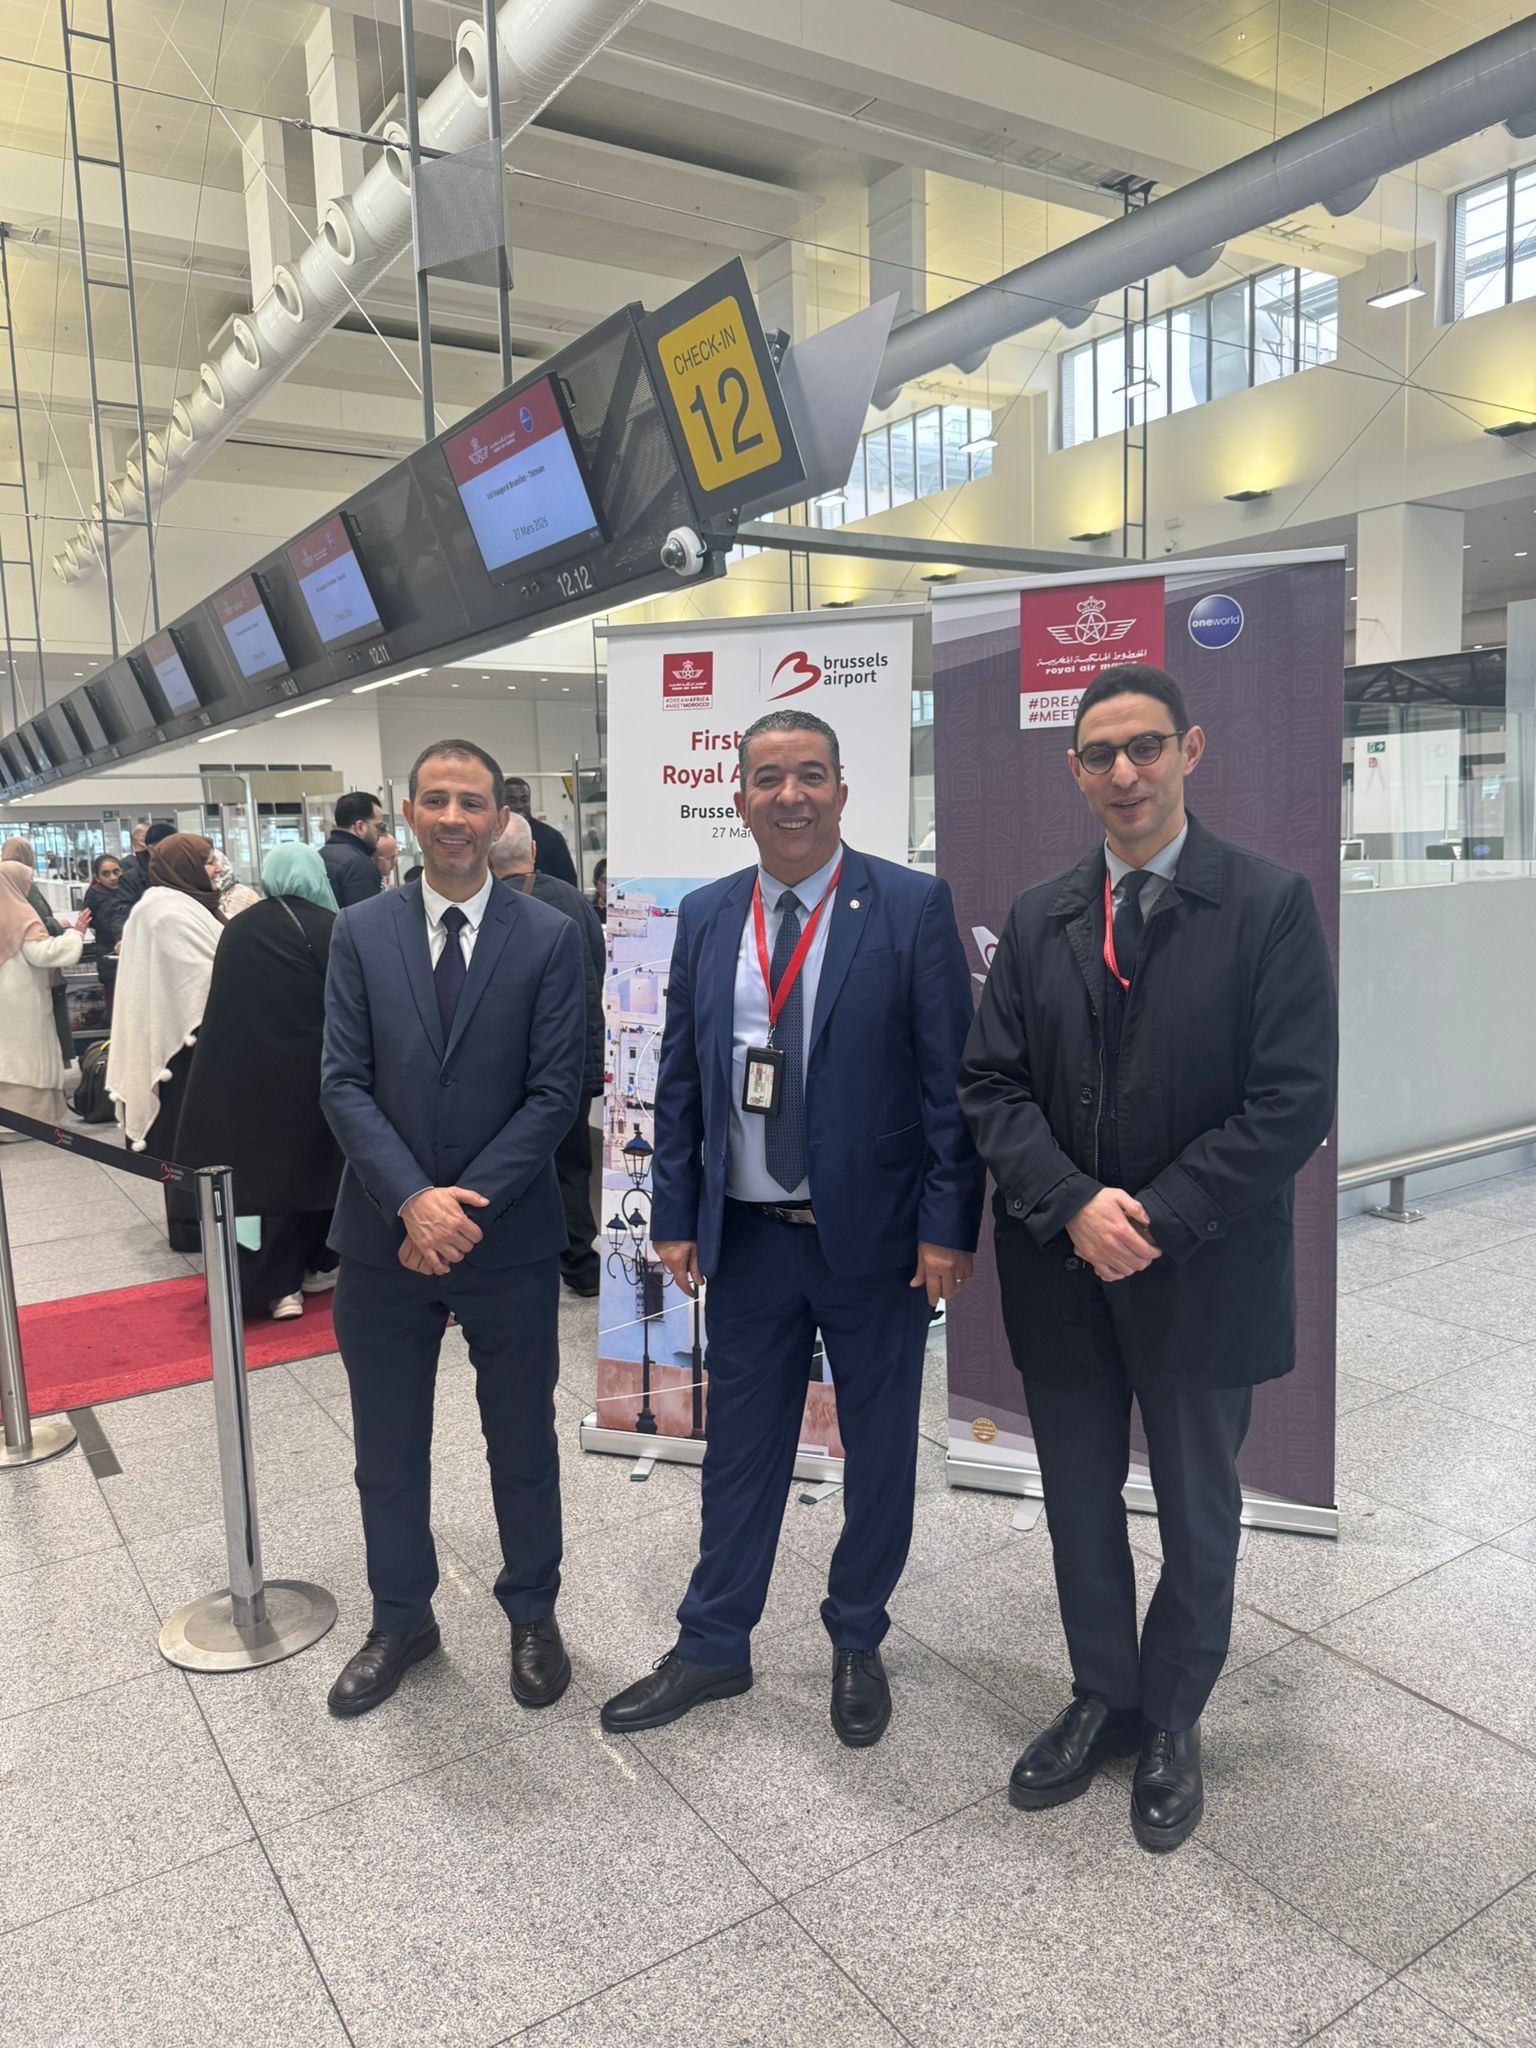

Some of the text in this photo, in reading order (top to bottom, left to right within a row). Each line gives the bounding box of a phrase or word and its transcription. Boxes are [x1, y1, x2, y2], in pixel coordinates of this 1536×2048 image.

[673, 324, 737, 376] CHECK-IN
[689, 366, 764, 464] 12
[557, 565, 593, 598] 12.12
[1191, 614, 1240, 628] oneworld
[823, 651, 889, 670] brussels
[1045, 665, 1075, 675] royal
[1079, 664, 1097, 672] air
[823, 669, 877, 688] airport
[1028, 695, 1080, 709] #DREA
[1028, 708, 1077, 723] #MEET
[691, 729, 742, 751] First
[662, 762, 724, 788] Royal
[712, 827, 726, 839] 27
